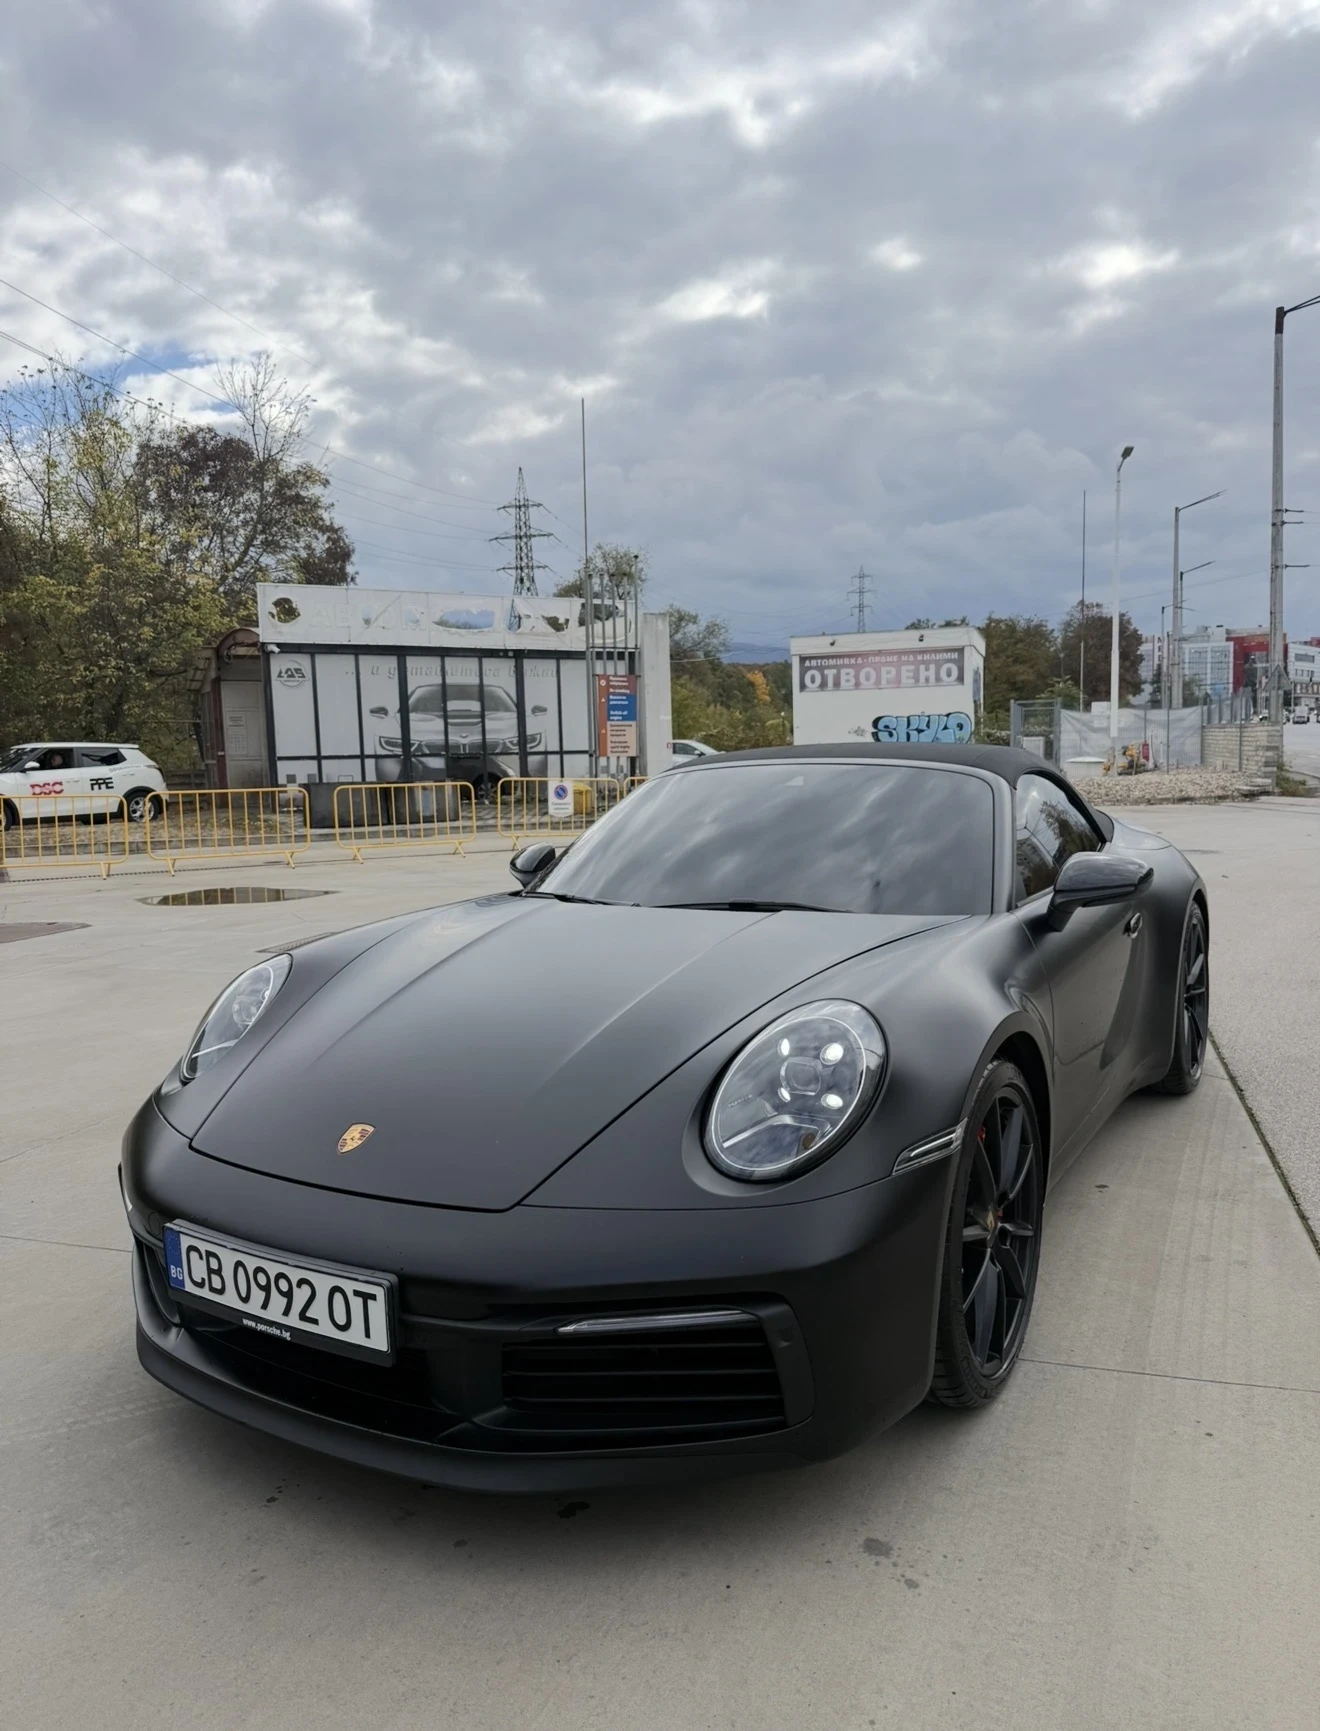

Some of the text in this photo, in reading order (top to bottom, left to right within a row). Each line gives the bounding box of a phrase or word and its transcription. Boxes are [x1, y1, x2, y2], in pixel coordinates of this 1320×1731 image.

[902, 654, 914, 662] НА
[917, 652, 959, 661] КИЛИМИ
[804, 663, 959, 689] ОТВОРЕНО
[30, 782, 64, 796] DSC
[90, 777, 114, 791] PPE
[170, 1265, 183, 1280] BG
[242, 1318, 292, 1341] www.porsche.bg
